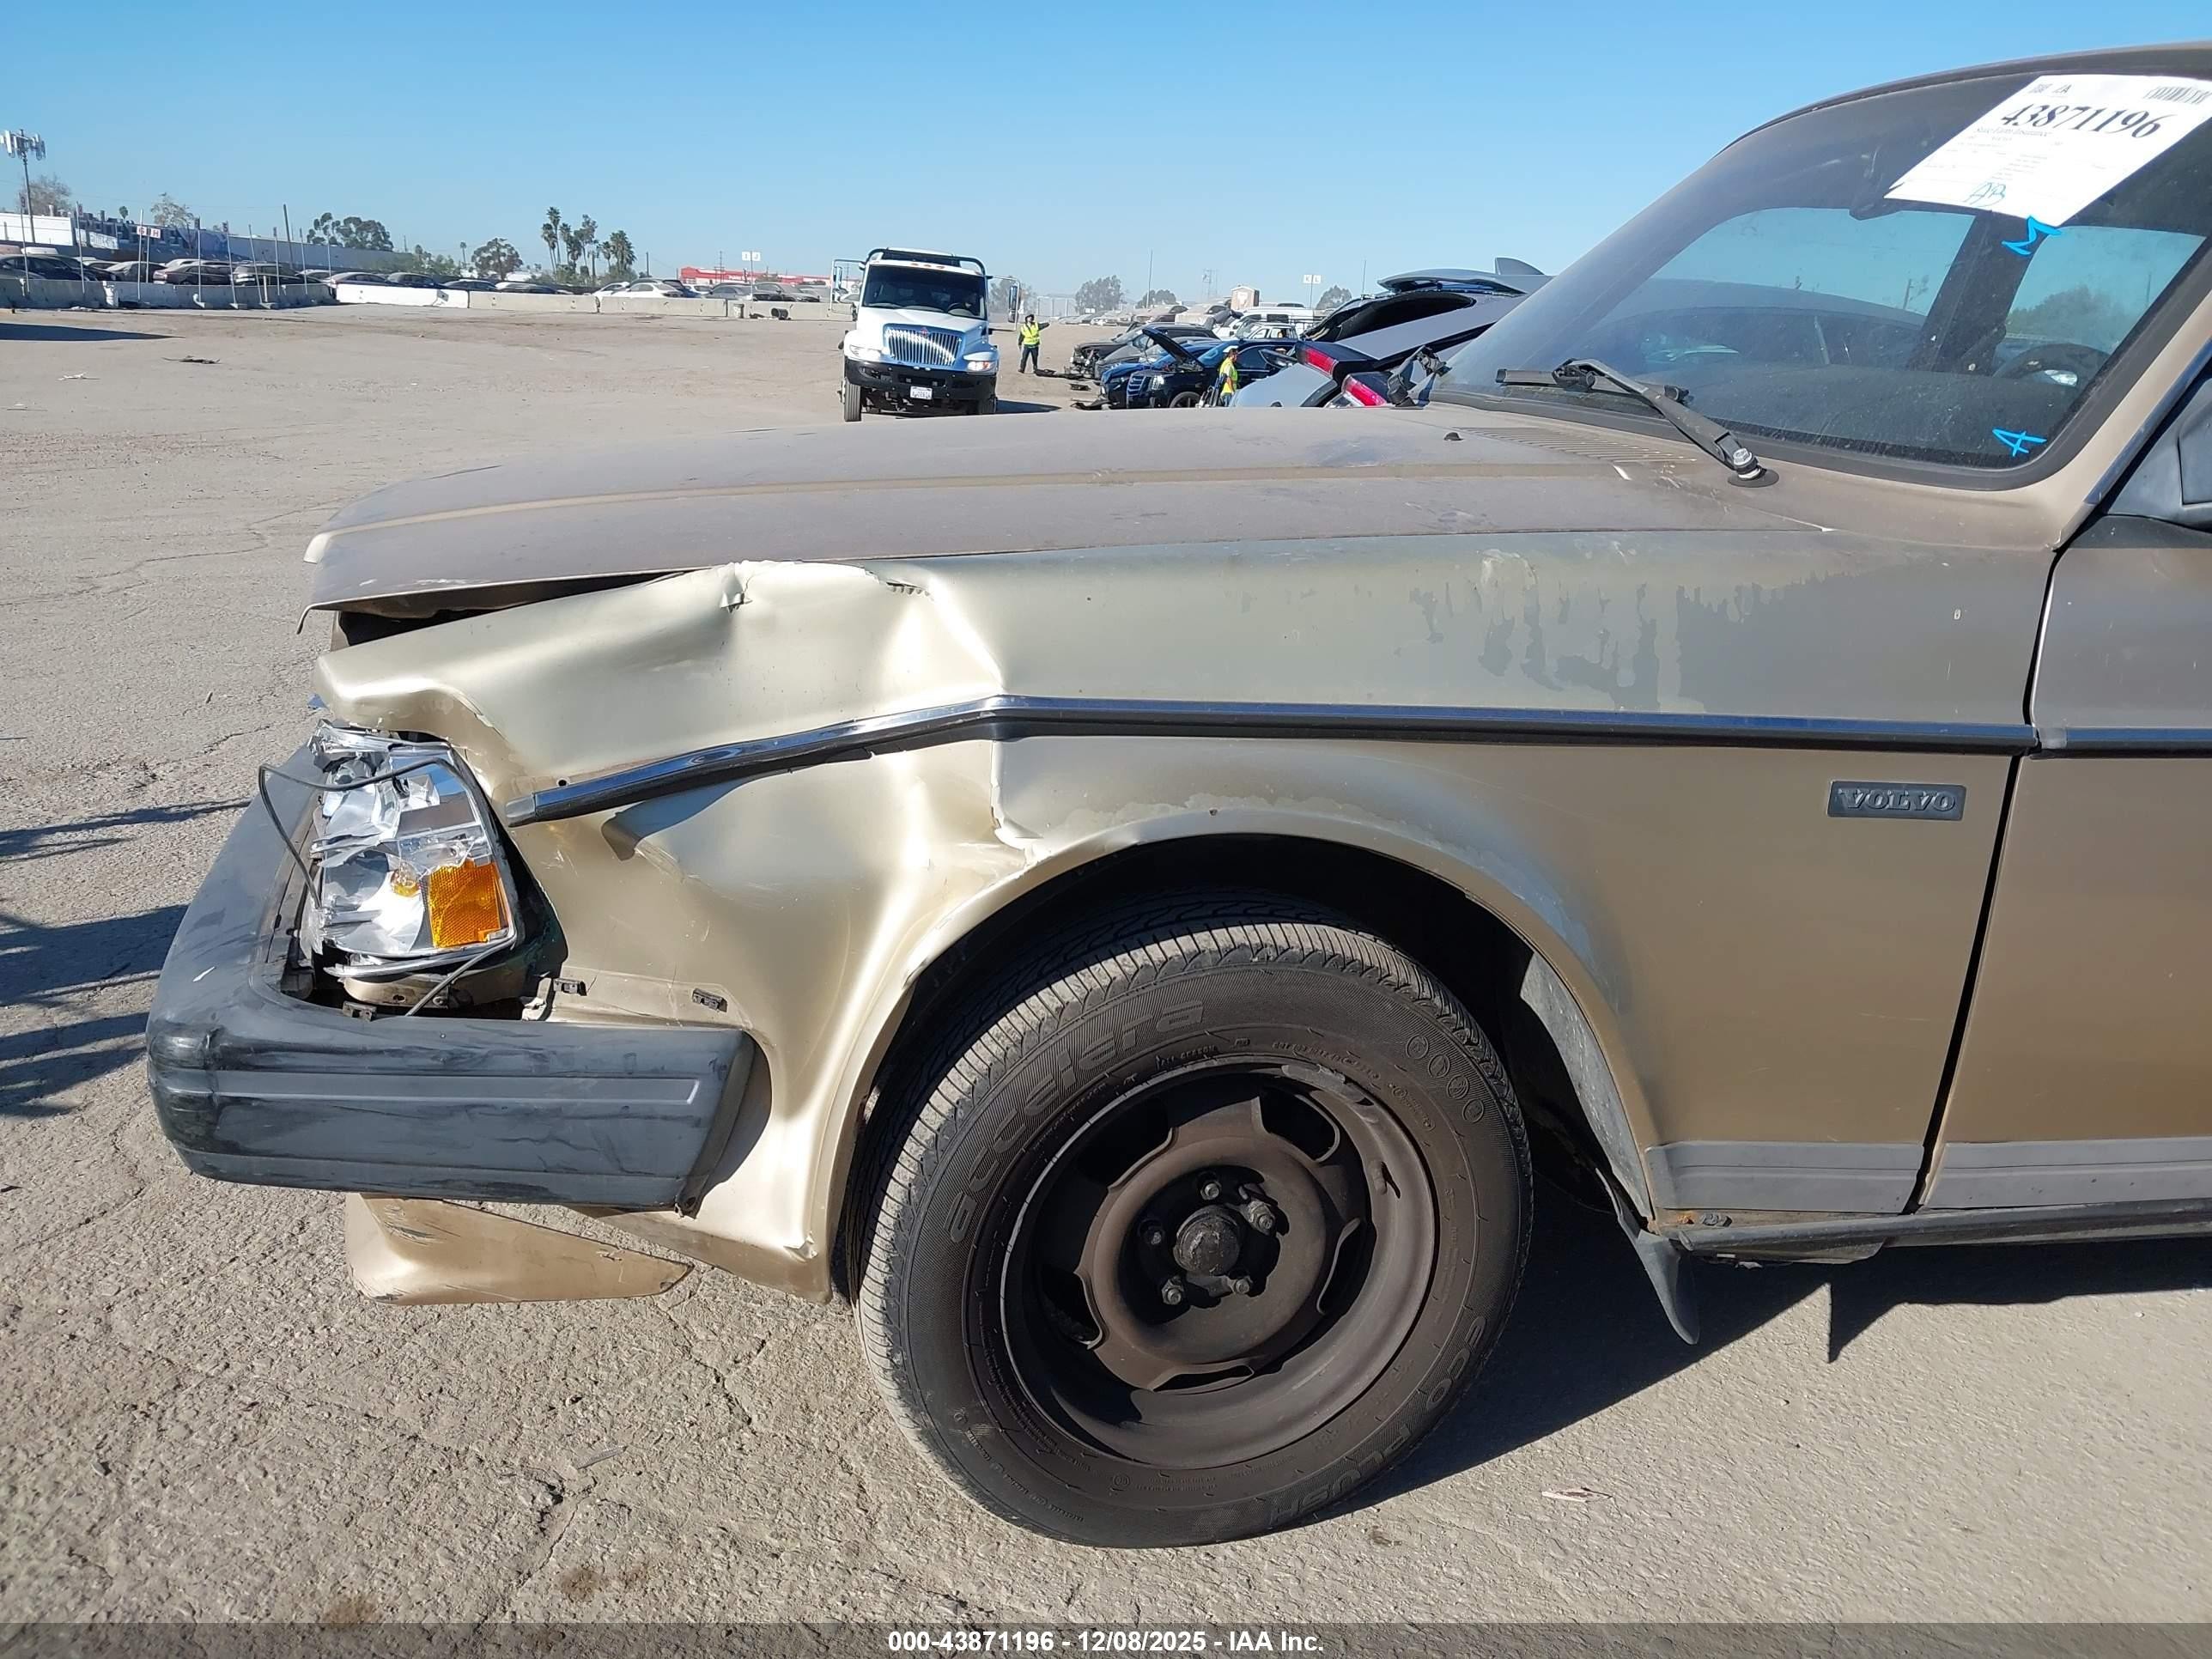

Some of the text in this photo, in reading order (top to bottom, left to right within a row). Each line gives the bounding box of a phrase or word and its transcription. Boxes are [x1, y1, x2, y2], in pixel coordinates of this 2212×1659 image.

[2001, 104, 2178, 137] 43871196
[1837, 787, 1956, 811] VOLVO
[1426, 1316, 1487, 1411] ECO
